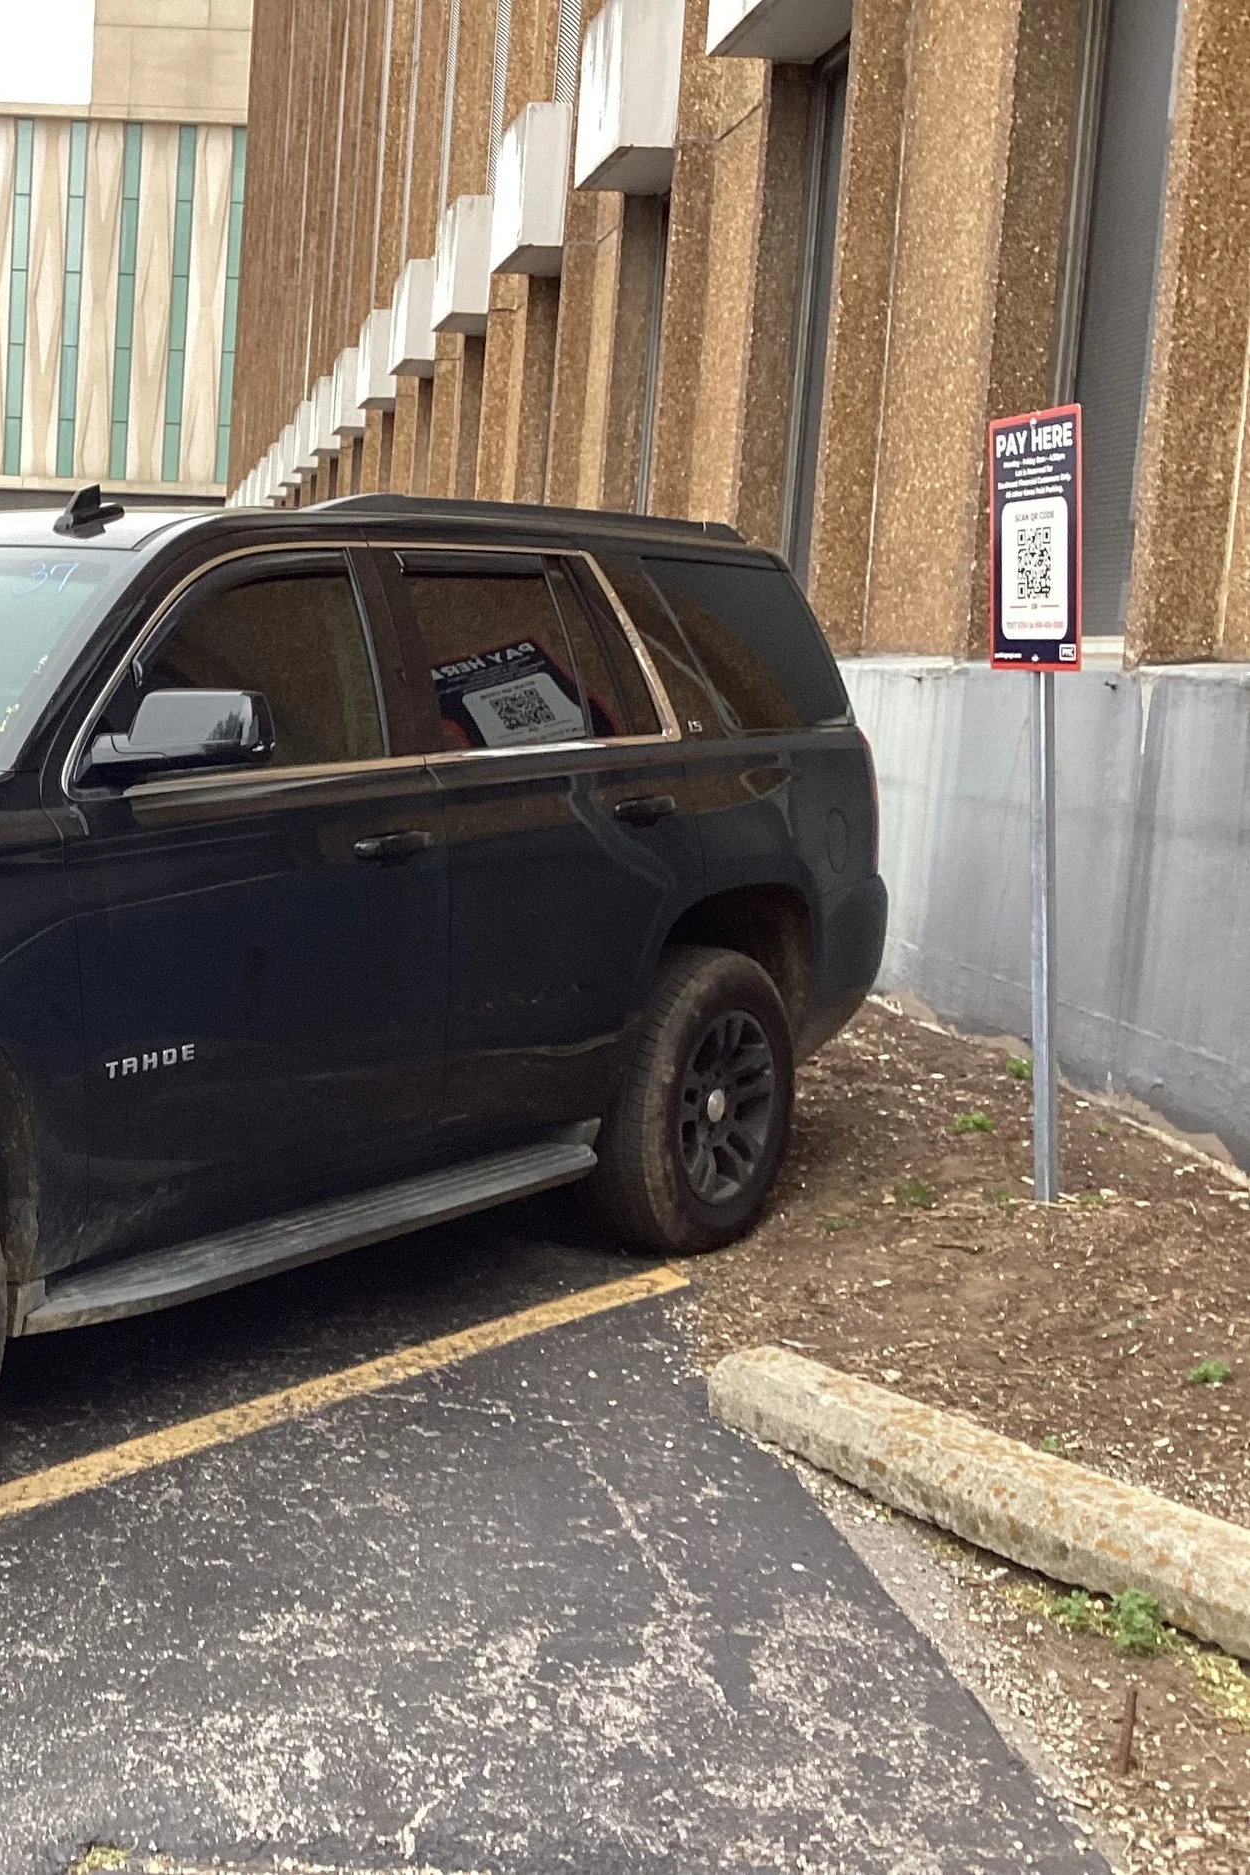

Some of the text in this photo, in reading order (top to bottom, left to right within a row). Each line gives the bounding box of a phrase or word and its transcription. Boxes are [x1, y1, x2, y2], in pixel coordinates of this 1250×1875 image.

[995, 422, 1073, 458] PAY HERE
[1015, 510, 1054, 522] SCAN QR CODE
[12, 562, 80, 595] 37
[687, 720, 703, 732] LS
[105, 1043, 195, 1080] TAHOE
